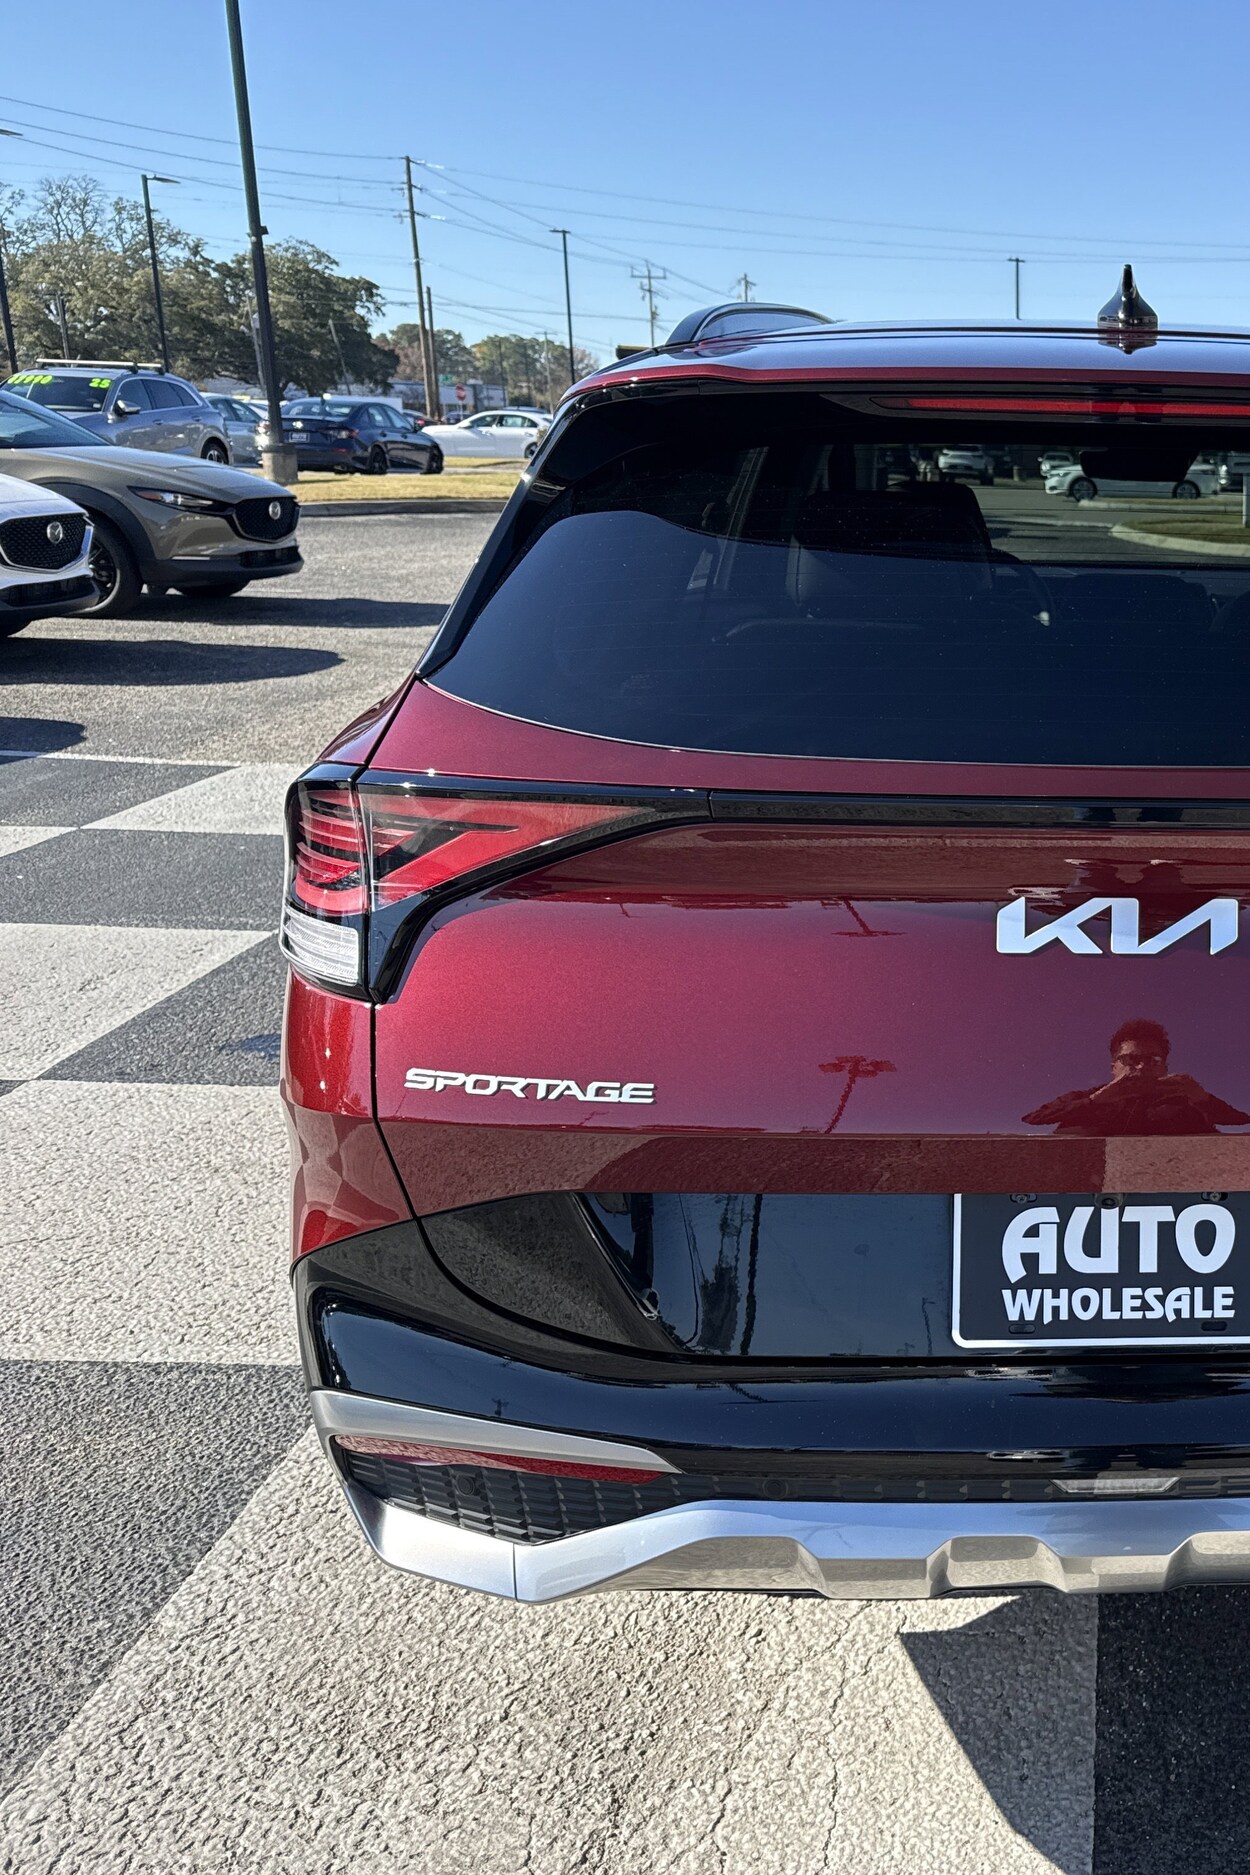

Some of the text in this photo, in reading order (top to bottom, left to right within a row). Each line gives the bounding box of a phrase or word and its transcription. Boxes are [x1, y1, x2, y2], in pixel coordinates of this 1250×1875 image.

[88, 377, 112, 389] 25
[996, 896, 1239, 955] KIA
[404, 1067, 655, 1104] SPORTAGE
[1001, 1203, 1236, 1284] AUTO
[1001, 1286, 1236, 1325] WHOLESALE
